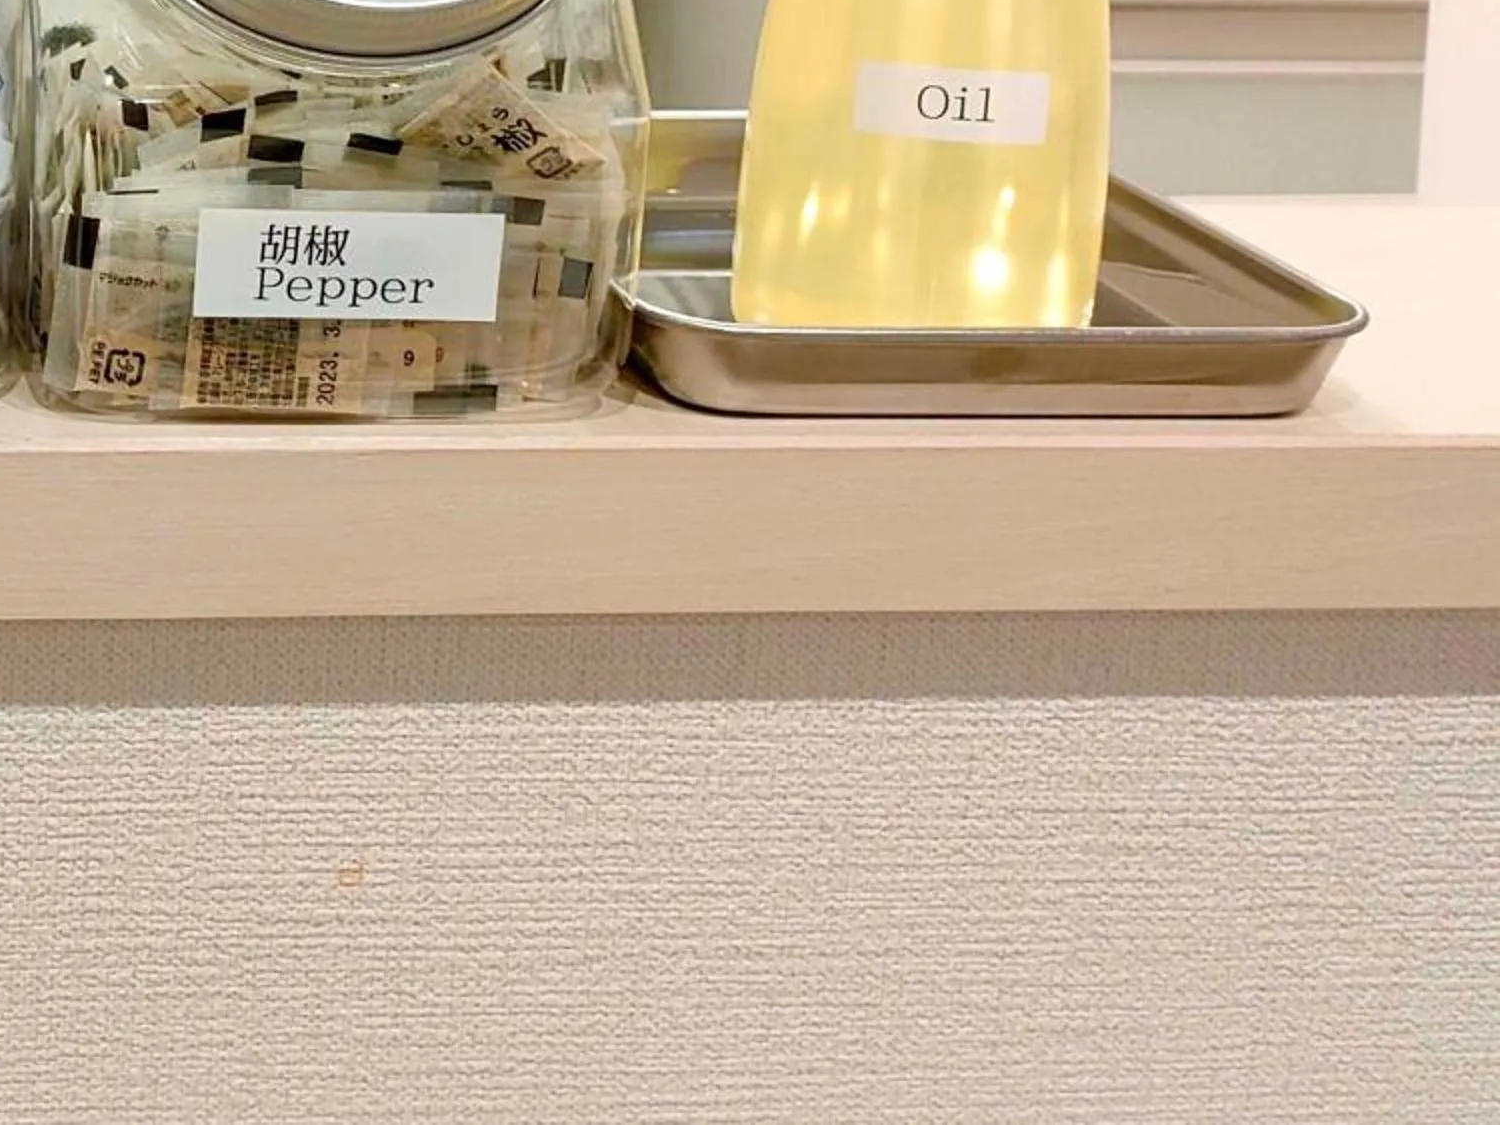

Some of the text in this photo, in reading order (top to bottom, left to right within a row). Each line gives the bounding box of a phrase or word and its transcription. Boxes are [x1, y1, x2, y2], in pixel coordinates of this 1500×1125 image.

[916, 83, 996, 124] Oil
[259, 225, 352, 267] 胡椒
[254, 266, 436, 308] Pepper
